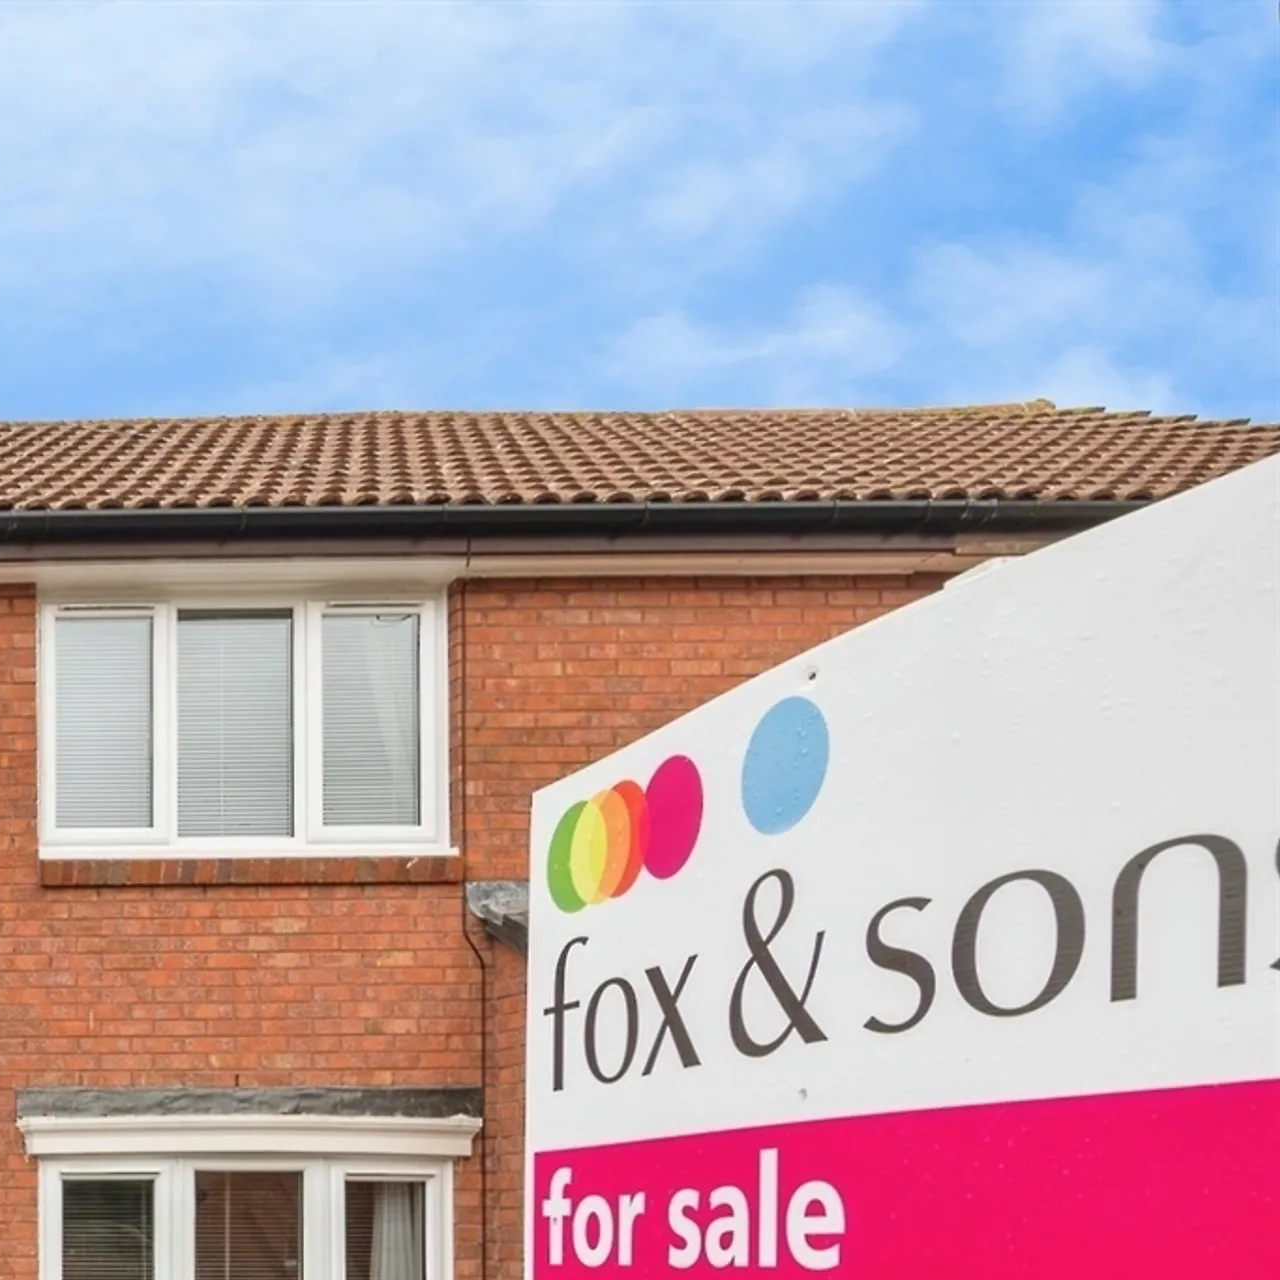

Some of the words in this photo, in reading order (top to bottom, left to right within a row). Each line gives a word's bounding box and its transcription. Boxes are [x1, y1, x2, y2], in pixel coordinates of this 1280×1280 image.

[544, 937, 702, 1092] fox
[729, 868, 828, 1058] &
[863, 834, 1280, 1034] son
[543, 1167, 645, 1268] for
[668, 1147, 846, 1271] sale
